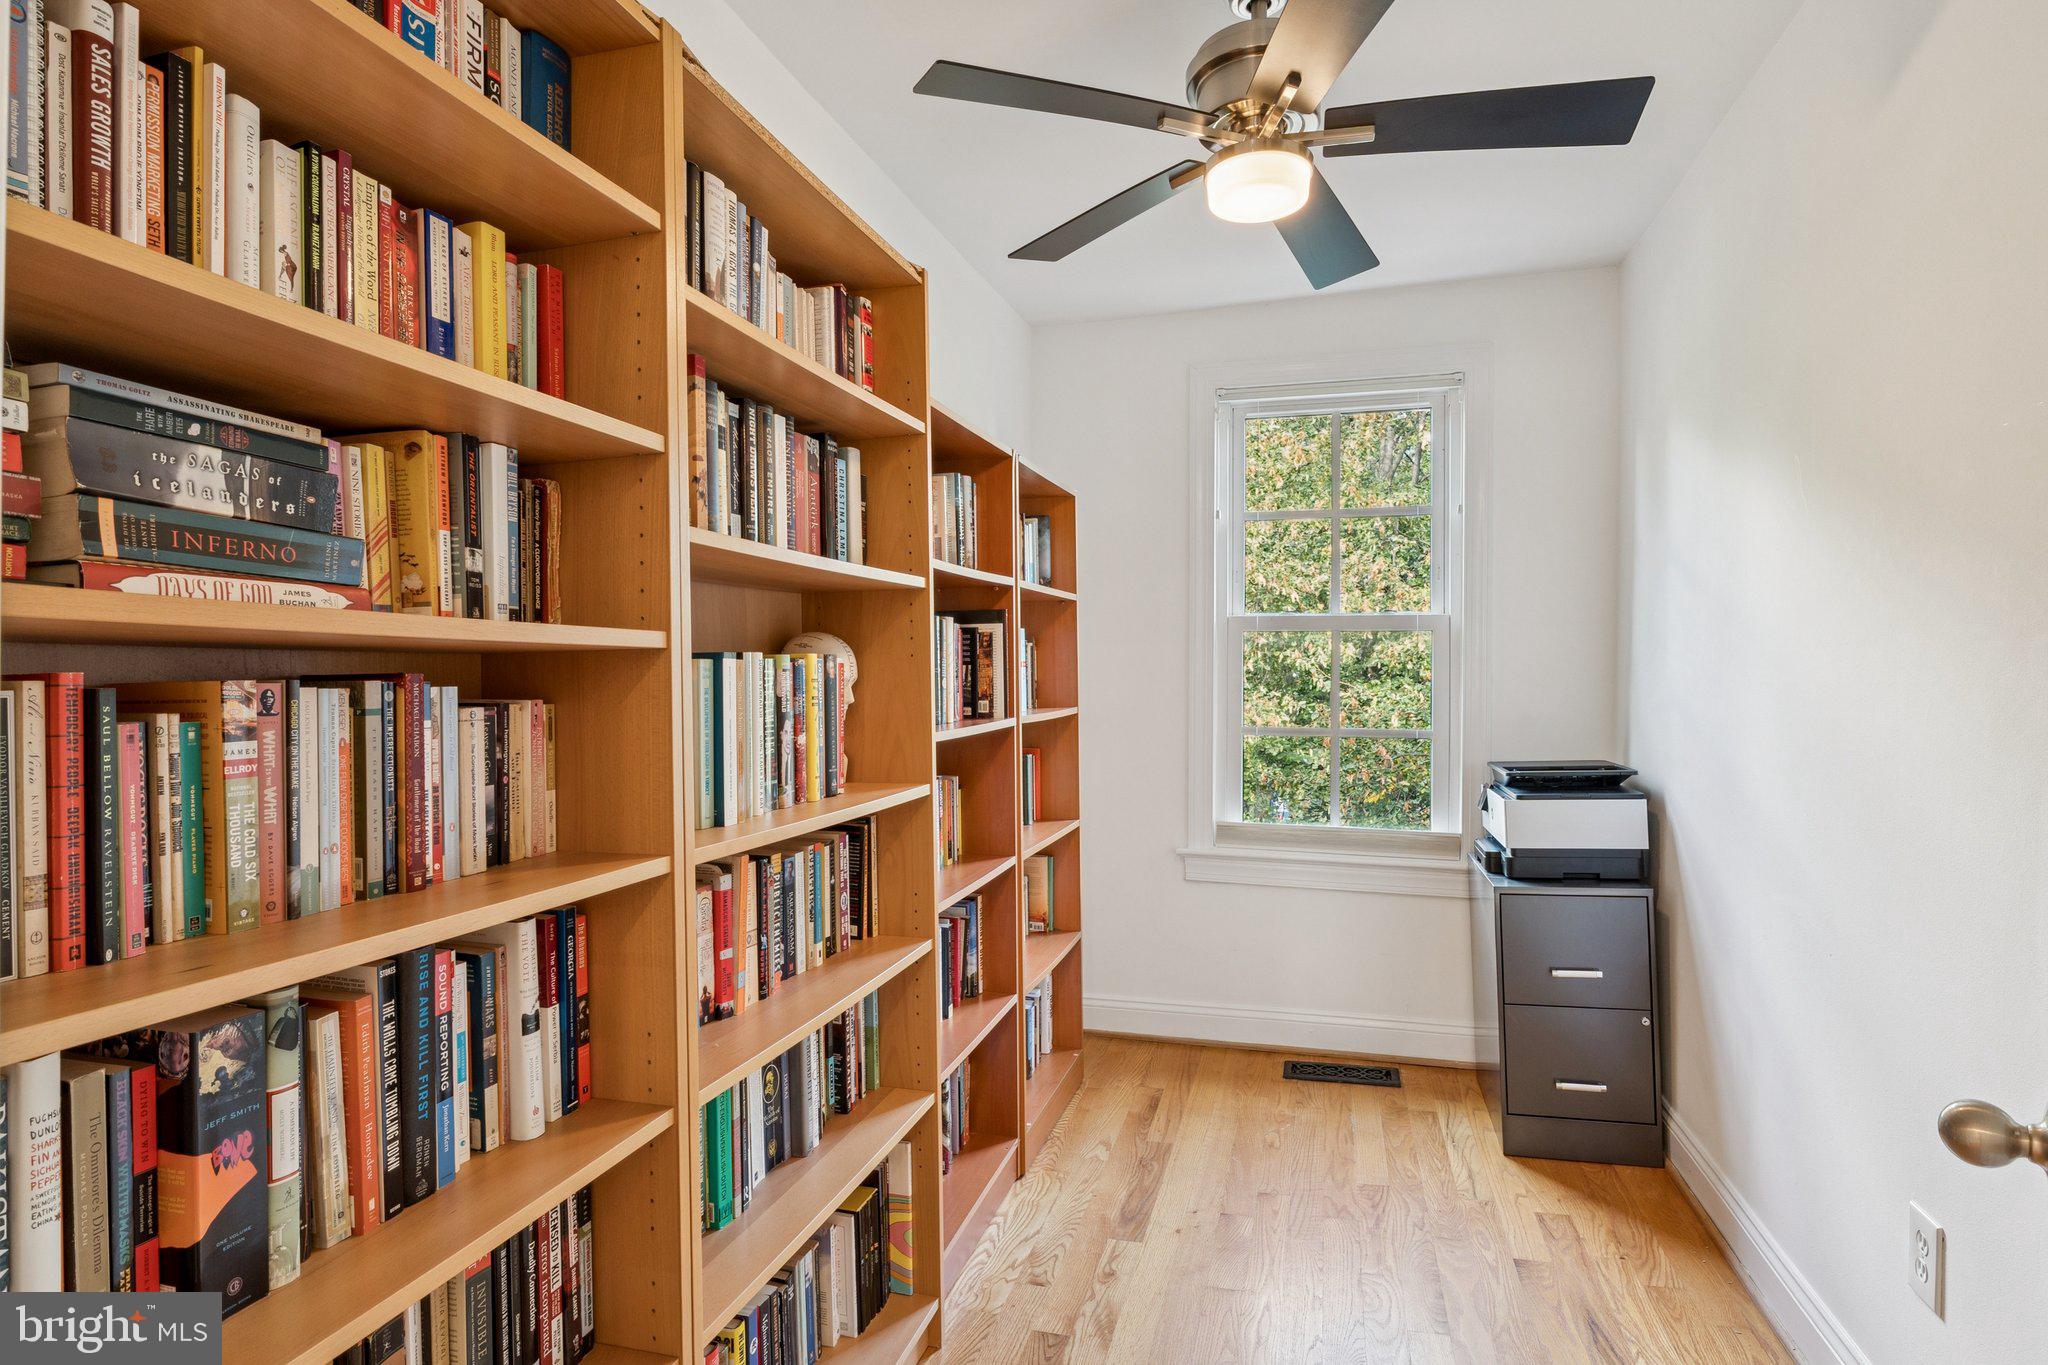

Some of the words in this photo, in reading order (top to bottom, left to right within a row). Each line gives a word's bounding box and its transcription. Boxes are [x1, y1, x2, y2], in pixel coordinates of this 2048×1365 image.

[466, 14, 482, 89] FIRM
[90, 43, 112, 99] SALES
[147, 80, 160, 150] PERMISSION
[90, 99, 112, 171] GROWTH
[246, 125, 256, 177] Outliers
[311, 154, 320, 174] DYING
[326, 166, 335, 182] DO
[147, 152, 160, 217] MARKETING
[311, 174, 320, 216] COLONIALISM
[326, 184, 335, 206] YOU
[342, 167, 351, 207] CRYSTAL
[362, 181, 376, 231] Empires
[728, 199, 738, 237] THOMAS
[147, 218, 161, 249] SETH
[311, 223, 320, 248] FRANTZ
[326, 207, 335, 239] SPEAK
[366, 234, 377, 248] of
[312, 248, 321, 270] FANON
[366, 248, 377, 267] the
[441, 263, 448, 271] OF
[728, 250, 738, 280] RICKS
[366, 270, 377, 302] Word
[441, 277, 449, 317] EXTREMES
[96, 379, 127, 391] THOMAS
[129, 386, 151, 398] GOLTZ
[145, 407, 155, 432] HARE
[166, 411, 174, 435] AMBER
[167, 395, 236, 418] ASSASSINATING
[238, 413, 295, 433] SHAKESPEARE
[748, 407, 757, 444] NIGHT
[468, 451, 477, 470] THE
[766, 427, 774, 463] CHAOS
[152, 452, 176, 465] the
[187, 453, 261, 481] SAGAS
[268, 476, 282, 487] of
[351, 470, 360, 494] NINE
[507, 471, 517, 489] BILL
[749, 446, 757, 487] DRAWS
[469, 473, 478, 537] ORIENTALIST
[507, 490, 518, 523] BRYSON
[766, 471, 774, 515] EMPIRE
[838, 468, 846, 524] CHRISTINA
[353, 497, 362, 537] STORIES
[140, 520, 149, 548] DANTE
[171, 530, 297, 564] INFERNO
[839, 529, 847, 557] LAMB
[5, 546, 13, 577] NORTON
[155, 574, 207, 600] DAYS
[213, 580, 234, 602] OF
[279, 599, 317, 608] BUCHAN
[283, 589, 312, 598] JAMES
[290, 699, 299, 728] CHICAGO
[338, 693, 347, 708] KEN
[386, 707, 394, 720] THE
[413, 682, 421, 720] MICHAEL
[65, 687, 79, 752] TEMPORARY
[102, 705, 111, 746] SAUL
[338, 709, 347, 731] KESEY
[224, 748, 257, 757] JAMES
[263, 729, 276, 767] WHAT
[290, 729, 299, 744] CITY
[290, 746, 299, 755] ON
[413, 722, 421, 758] CHABON
[224, 764, 258, 775] ELLROY
[290, 757, 299, 769] THE
[386, 723, 395, 791] IMPERFECTIONISTS
[66, 757, 80, 798] PEOPLE
[103, 755, 112, 820] BELLOW
[290, 770, 299, 790] MAKE
[243, 802, 255, 824] THE
[263, 786, 277, 825] WHAT
[291, 796, 299, 818] Nelson
[66, 807, 80, 849] DEEPAK
[229, 803, 241, 868] THOUSAND
[244, 828, 256, 857] COLD
[290, 820, 299, 841] Algren
[2, 842, 10, 890] GLADKOV
[31, 840, 40, 866] SAID
[103, 828, 113, 927] RAVELSTEIN
[244, 862, 257, 882] SIX
[267, 869, 275, 896] EGGERS
[2, 899, 11, 941] CEMENT
[418, 953, 430, 991] RISE
[549, 950, 557, 966] The
[567, 935, 576, 979] GEORGIA
[438, 963, 448, 1010] SOUND
[549, 967, 557, 995] Culture
[382, 998, 396, 1022] THE
[418, 996, 429, 1028] AND
[485, 998, 495, 1028] WARS
[550, 997, 557, 1005] of
[551, 1007, 559, 1029] Power
[361, 1023, 371, 1054] Edith
[383, 1024, 397, 1058] WALLS
[417, 1034, 429, 1070] KILL
[439, 1016, 450, 1091] REPORTING
[362, 1056, 373, 1110] Pearlman
[384, 1060, 398, 1086] CAME
[115, 1079, 128, 1129] BLACK
[139, 1080, 149, 1118] DYING
[385, 1087, 399, 1140] TUMBLING
[417, 1074, 429, 1121] FIRST
[29, 1109, 61, 1126] FUCHSI
[30, 1121, 61, 1140] DUNLO
[89, 1111, 102, 1138] The
[140, 1121, 149, 1137] TO
[204, 1115, 227, 1131] JEFF
[230, 1103, 260, 1120] SMITH
[441, 1103, 450, 1134] Jonathan
[30, 1151, 50, 1167] FIN
[116, 1129, 128, 1163] SKIN
[141, 1140, 150, 1163] WIN
[363, 1121, 375, 1181] Honeydew
[386, 1140, 400, 1172] DOWN
[415, 1135, 423, 1178] BERGMAN
[423, 1138, 431, 1167] RONEN
[79, 1152, 88, 1200] MICHAEL
[89, 1141, 104, 1213] Omnivore's
[116, 1163, 130, 1218] WHITE
[31, 1216, 54, 1230] CHINA
[80, 1204, 89, 1247] POLLAN
[550, 1206, 562, 1253] ICENSED
[91, 1214, 105, 1274] Dilemma
[118, 1218, 131, 1265] MASKS
[527, 1241, 537, 1273] Deadly
[540, 1240, 549, 1275] terror
[550, 1264, 562, 1290] KILL
[528, 1273, 537, 1332] Connections
[540, 1279, 552, 1358] incorporated
[476, 1280, 488, 1360] INVISIBLE
